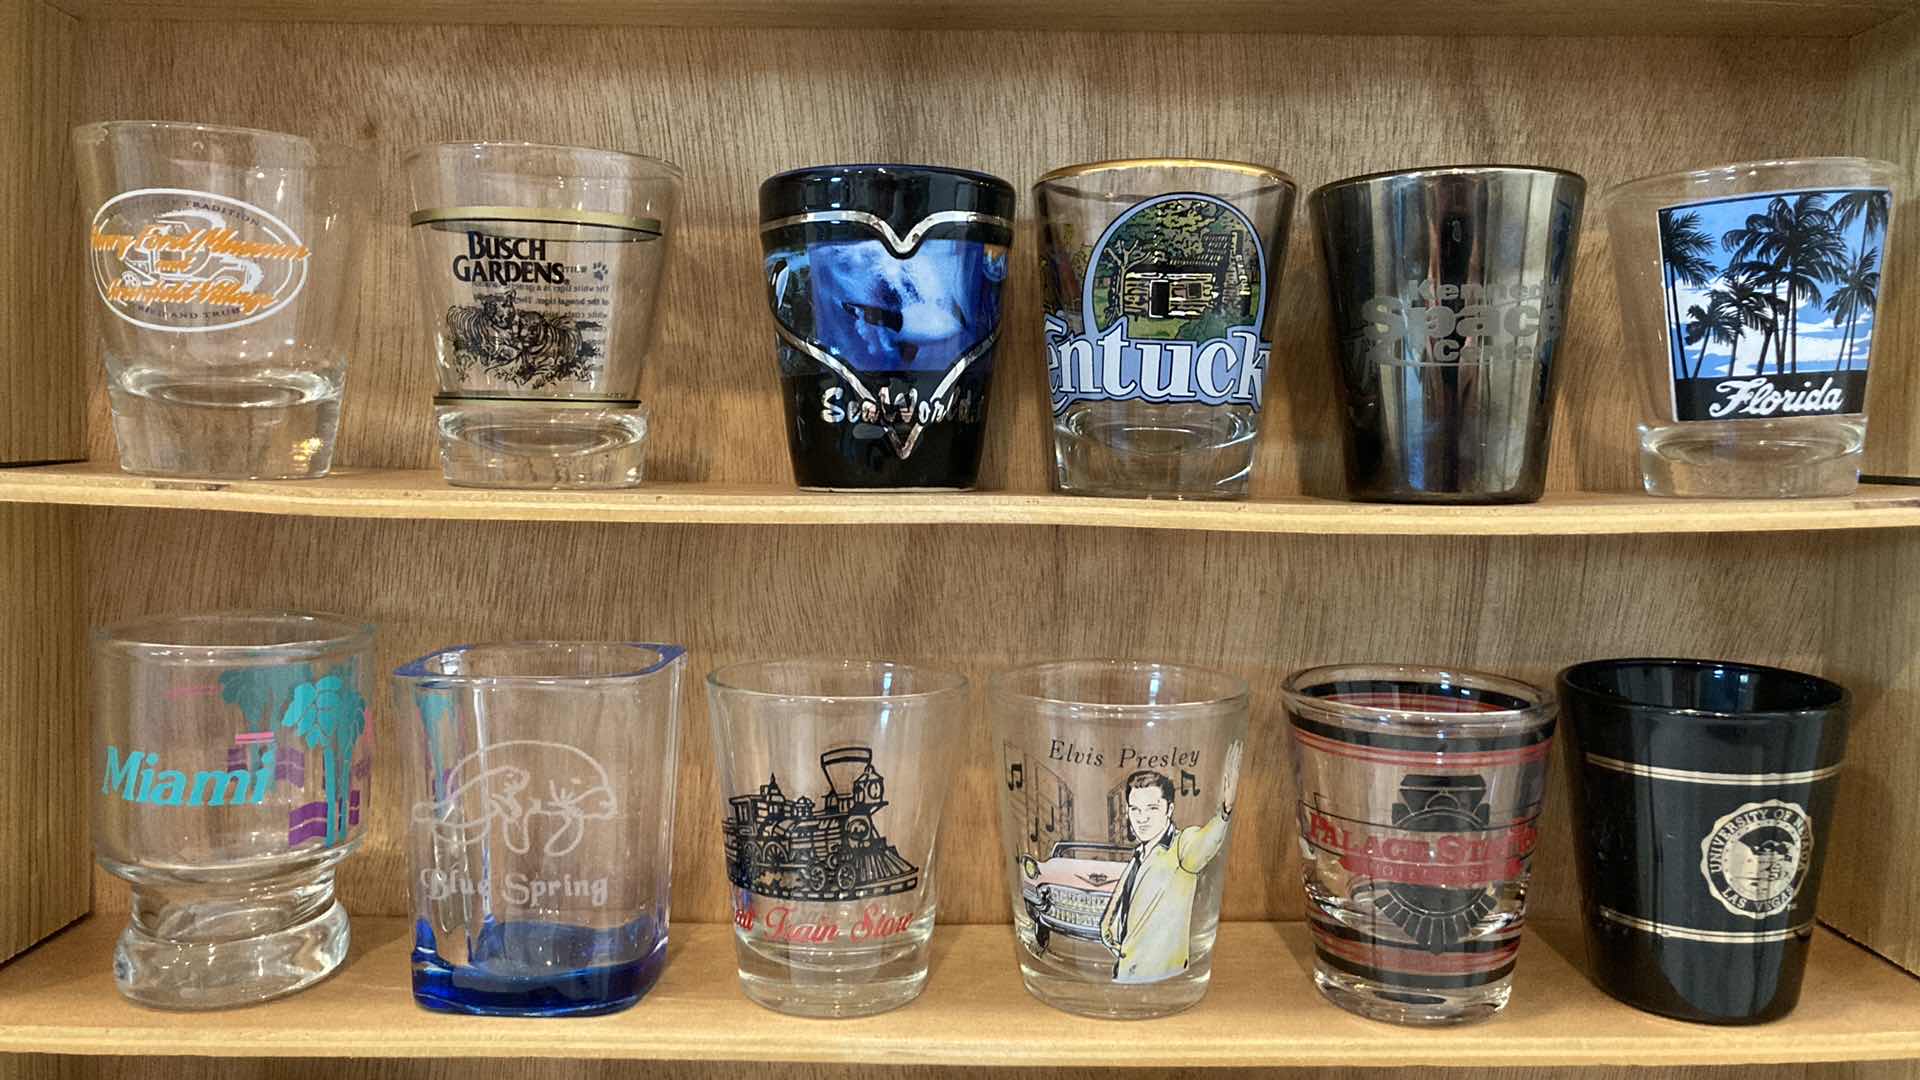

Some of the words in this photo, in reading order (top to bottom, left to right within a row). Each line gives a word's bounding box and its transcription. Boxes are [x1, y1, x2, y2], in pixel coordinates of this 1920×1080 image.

[186, 200, 261, 226] TRADITION
[467, 231, 546, 261] BUSCH
[452, 255, 566, 285] GARDENS
[170, 309, 199, 318] AND
[1708, 376, 1845, 418] Florida
[1048, 738, 1106, 768] Elvis
[1119, 747, 1203, 770] Presley
[101, 745, 275, 807] Miami
[1709, 808, 1769, 874] UNIVERSITY
[1773, 808, 1793, 822] OF
[501, 872, 610, 908] Spring
[1721, 886, 1748, 909] LAS
